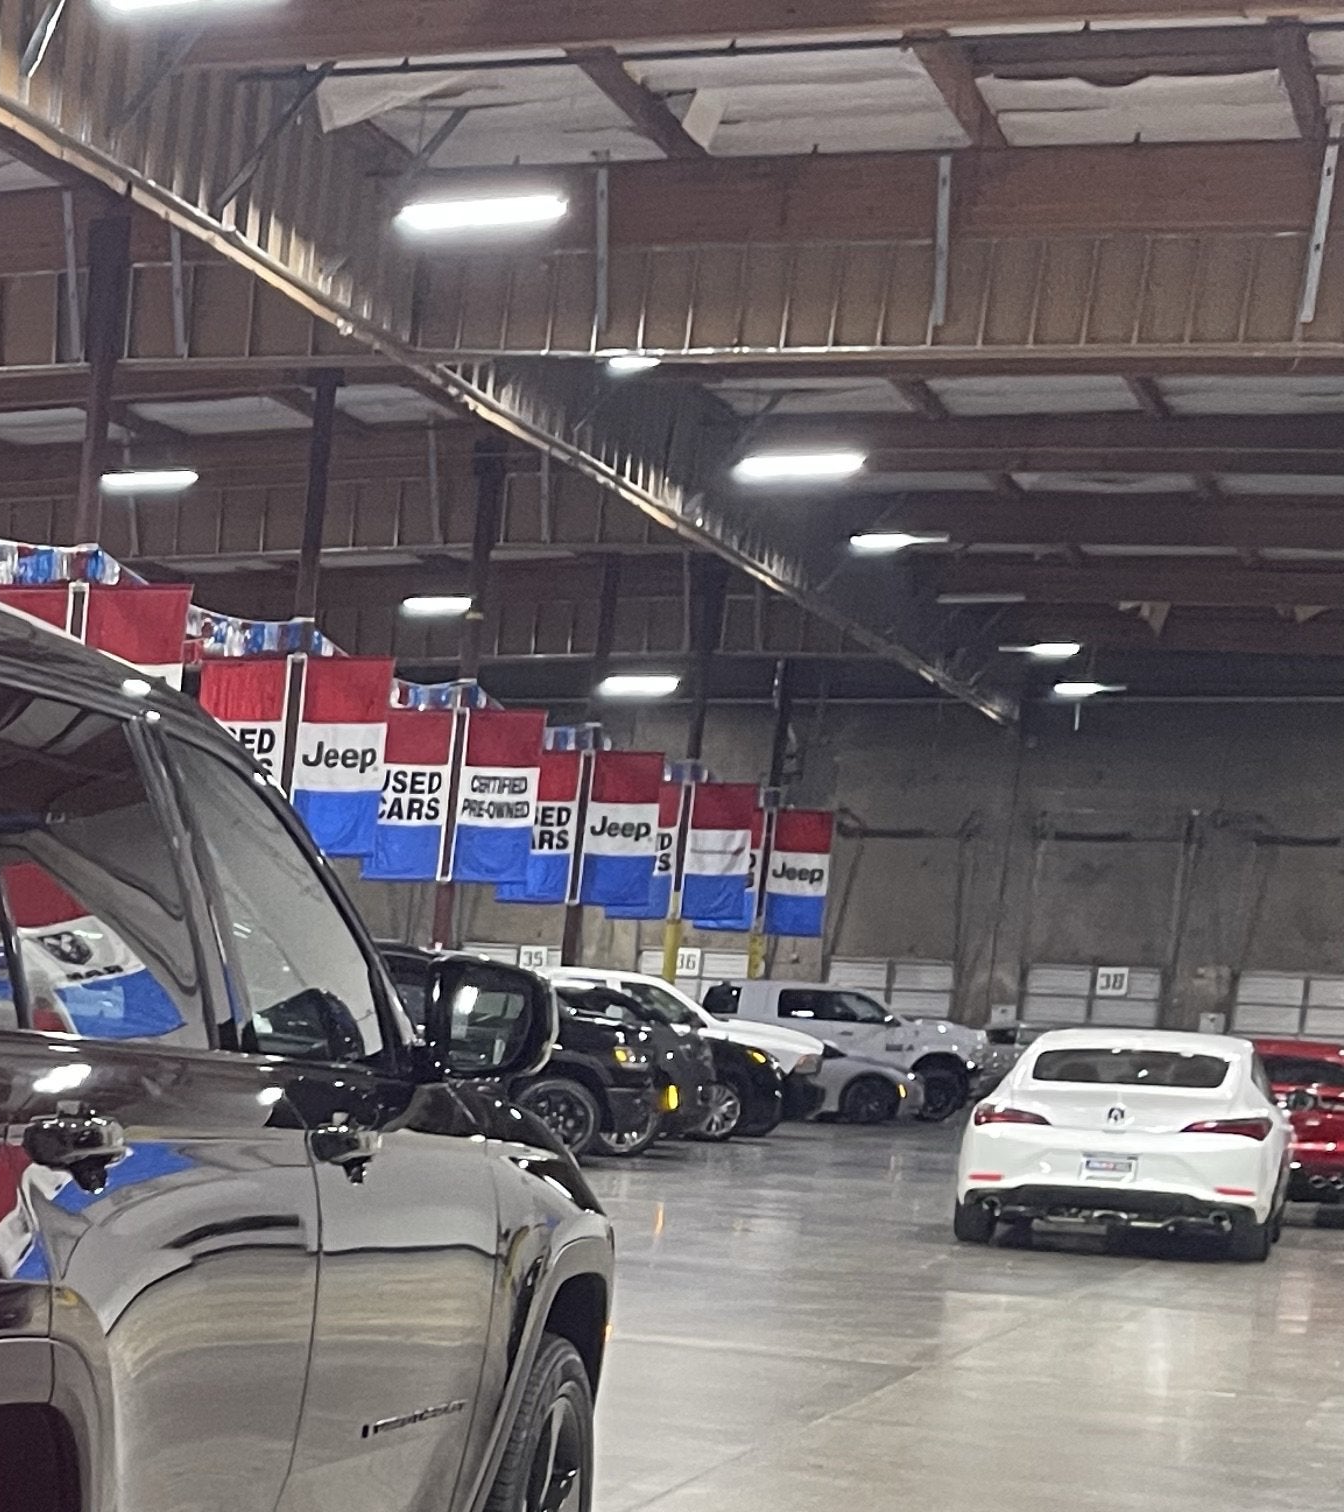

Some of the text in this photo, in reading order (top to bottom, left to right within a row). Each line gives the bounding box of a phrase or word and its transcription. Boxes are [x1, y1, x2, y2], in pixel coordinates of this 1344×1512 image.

[228, 727, 276, 755] ED
[301, 741, 377, 774] Jeep
[590, 815, 652, 842] Jeep
[772, 861, 824, 885] Jeep
[522, 950, 543, 967] 35
